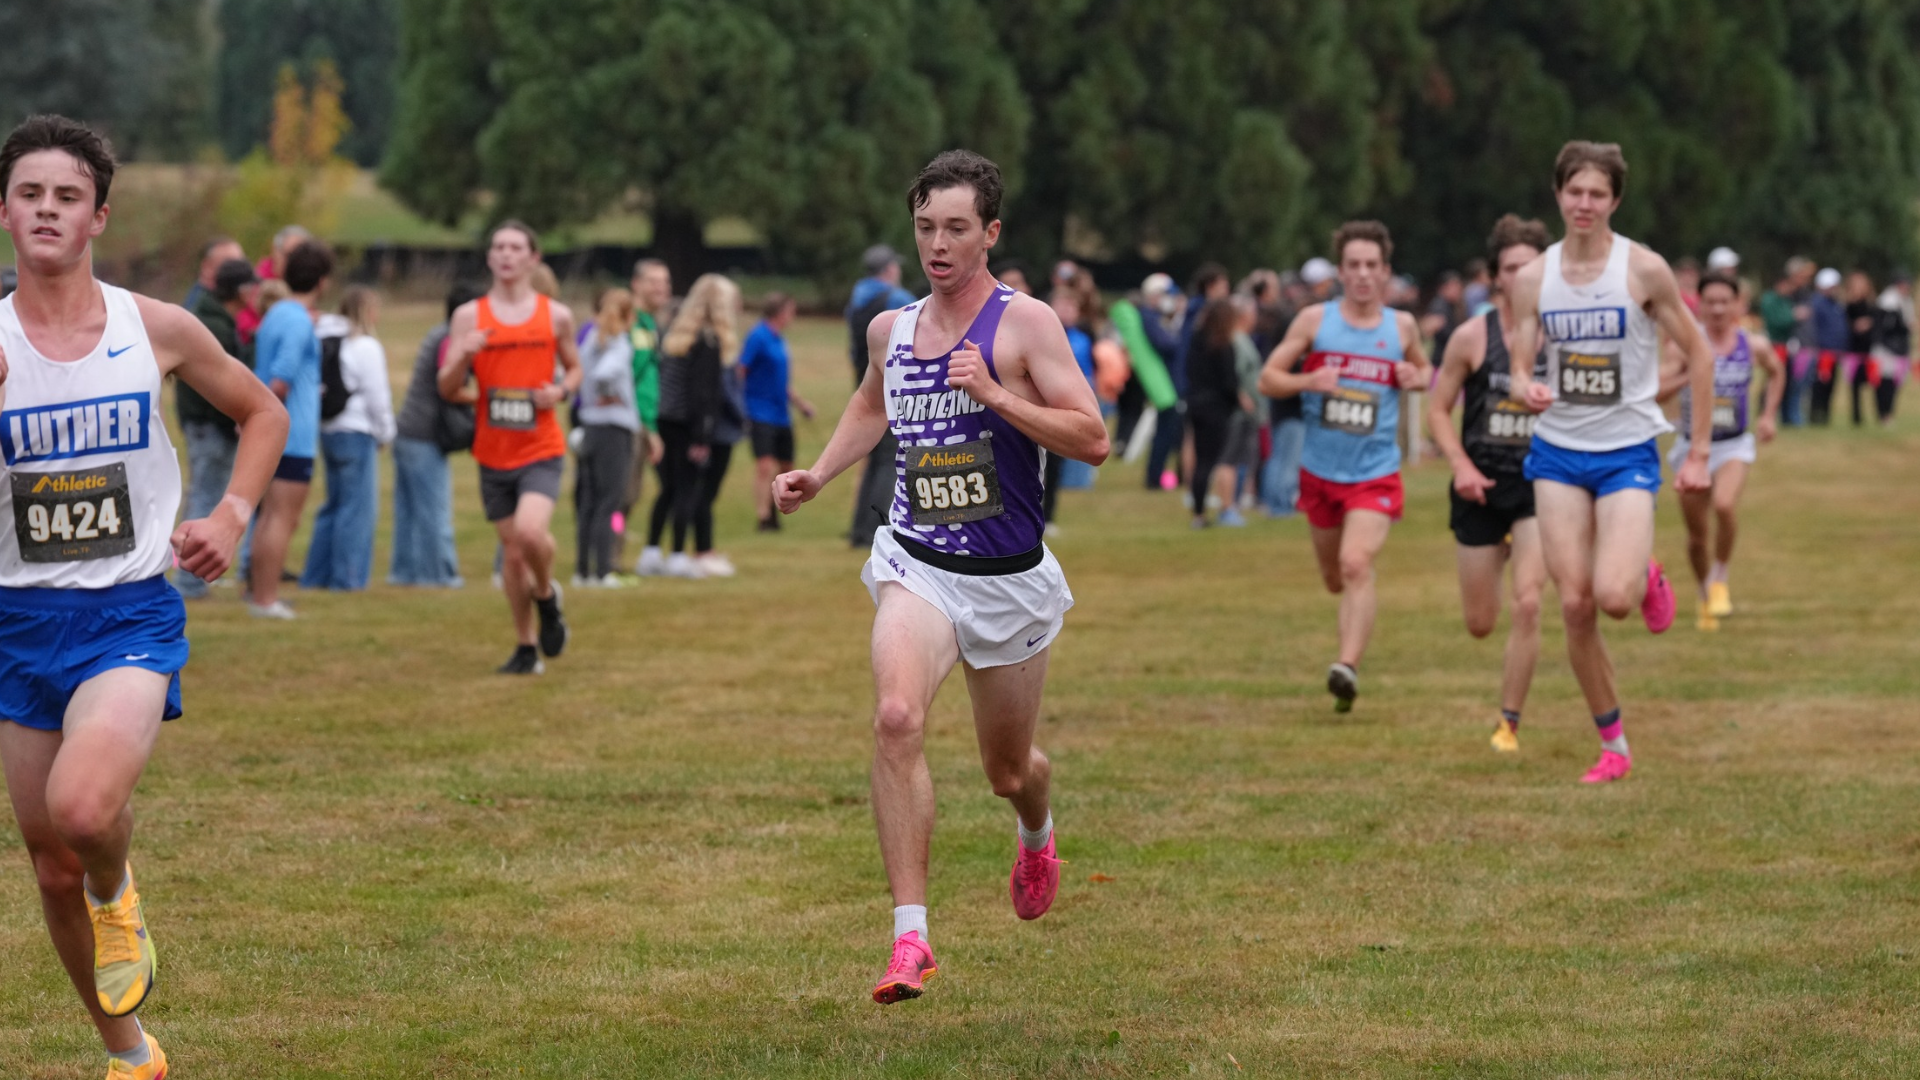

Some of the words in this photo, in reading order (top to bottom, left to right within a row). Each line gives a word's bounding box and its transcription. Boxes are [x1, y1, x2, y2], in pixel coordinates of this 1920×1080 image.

[1545, 309, 1621, 341] LUTHER
[1563, 368, 1615, 395] 9425
[10, 399, 141, 460] LUTHER
[918, 452, 975, 467] Athletic
[32, 475, 107, 493] Athletic
[915, 472, 989, 509] 9583
[27, 497, 121, 542] 9424
